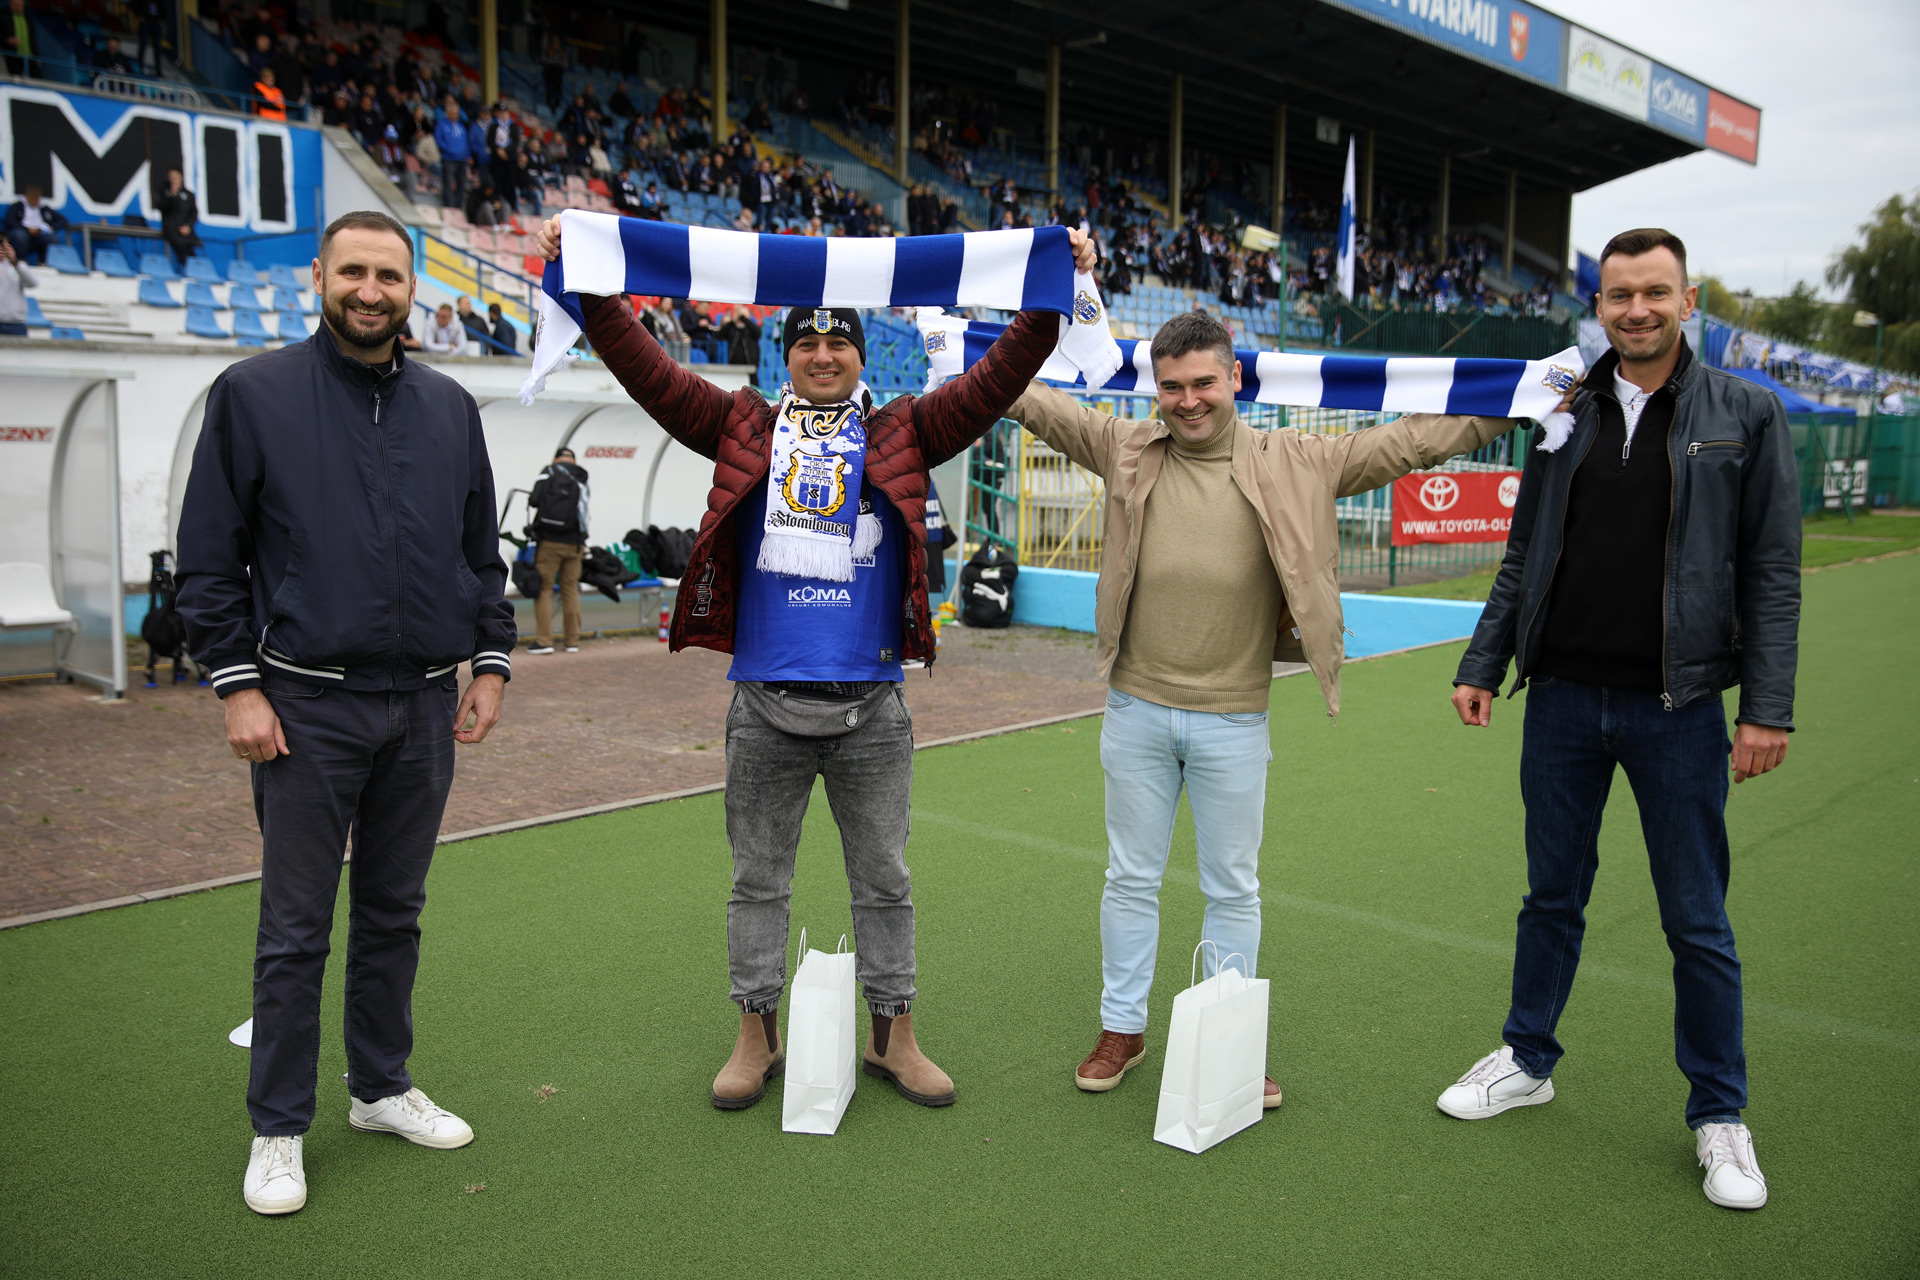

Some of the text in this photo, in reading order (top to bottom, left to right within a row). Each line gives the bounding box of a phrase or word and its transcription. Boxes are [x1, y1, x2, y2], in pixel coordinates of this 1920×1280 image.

[1652, 78, 1698, 119] KOMA
[810, 460, 826, 468] OKS
[803, 467, 828, 477] STOMIL
[798, 475, 834, 486] OLSZTYN
[769, 510, 850, 538] Stomilowcy
[788, 586, 851, 602] KOMA
